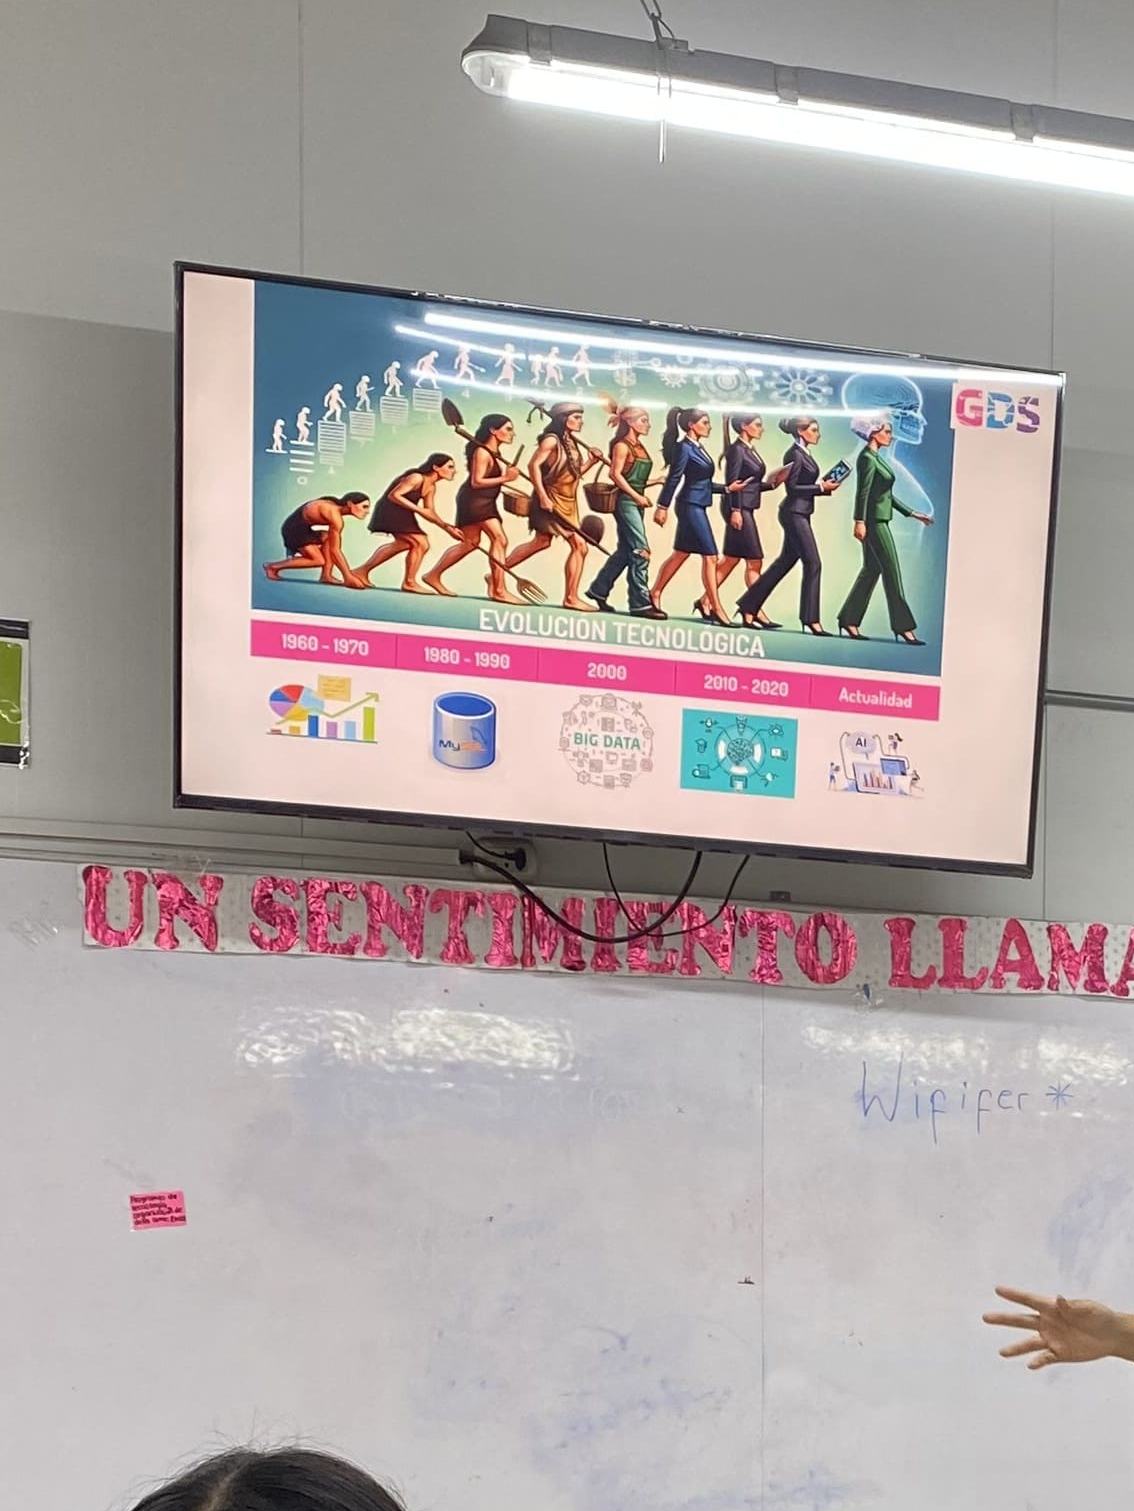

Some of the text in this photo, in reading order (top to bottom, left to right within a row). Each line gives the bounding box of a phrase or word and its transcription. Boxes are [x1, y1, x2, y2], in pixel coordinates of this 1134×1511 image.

[956, 388, 1040, 433] GDS
[281, 633, 317, 651] 1960
[334, 637, 369, 656] 1970
[479, 608, 766, 658] EVOLUCIÓN TECNOLÓGICA
[424, 646, 460, 665] 1980
[475, 651, 510, 669] 1990
[587, 661, 628, 681] 2000
[704, 674, 738, 692] 2010
[751, 678, 789, 697] 2020
[838, 686, 913, 708] Actualidad
[573, 731, 641, 751] BIG DATA
[855, 736, 867, 747] AI
[81, 864, 224, 952] UN
[248, 876, 857, 985] SENTIMIENTO
